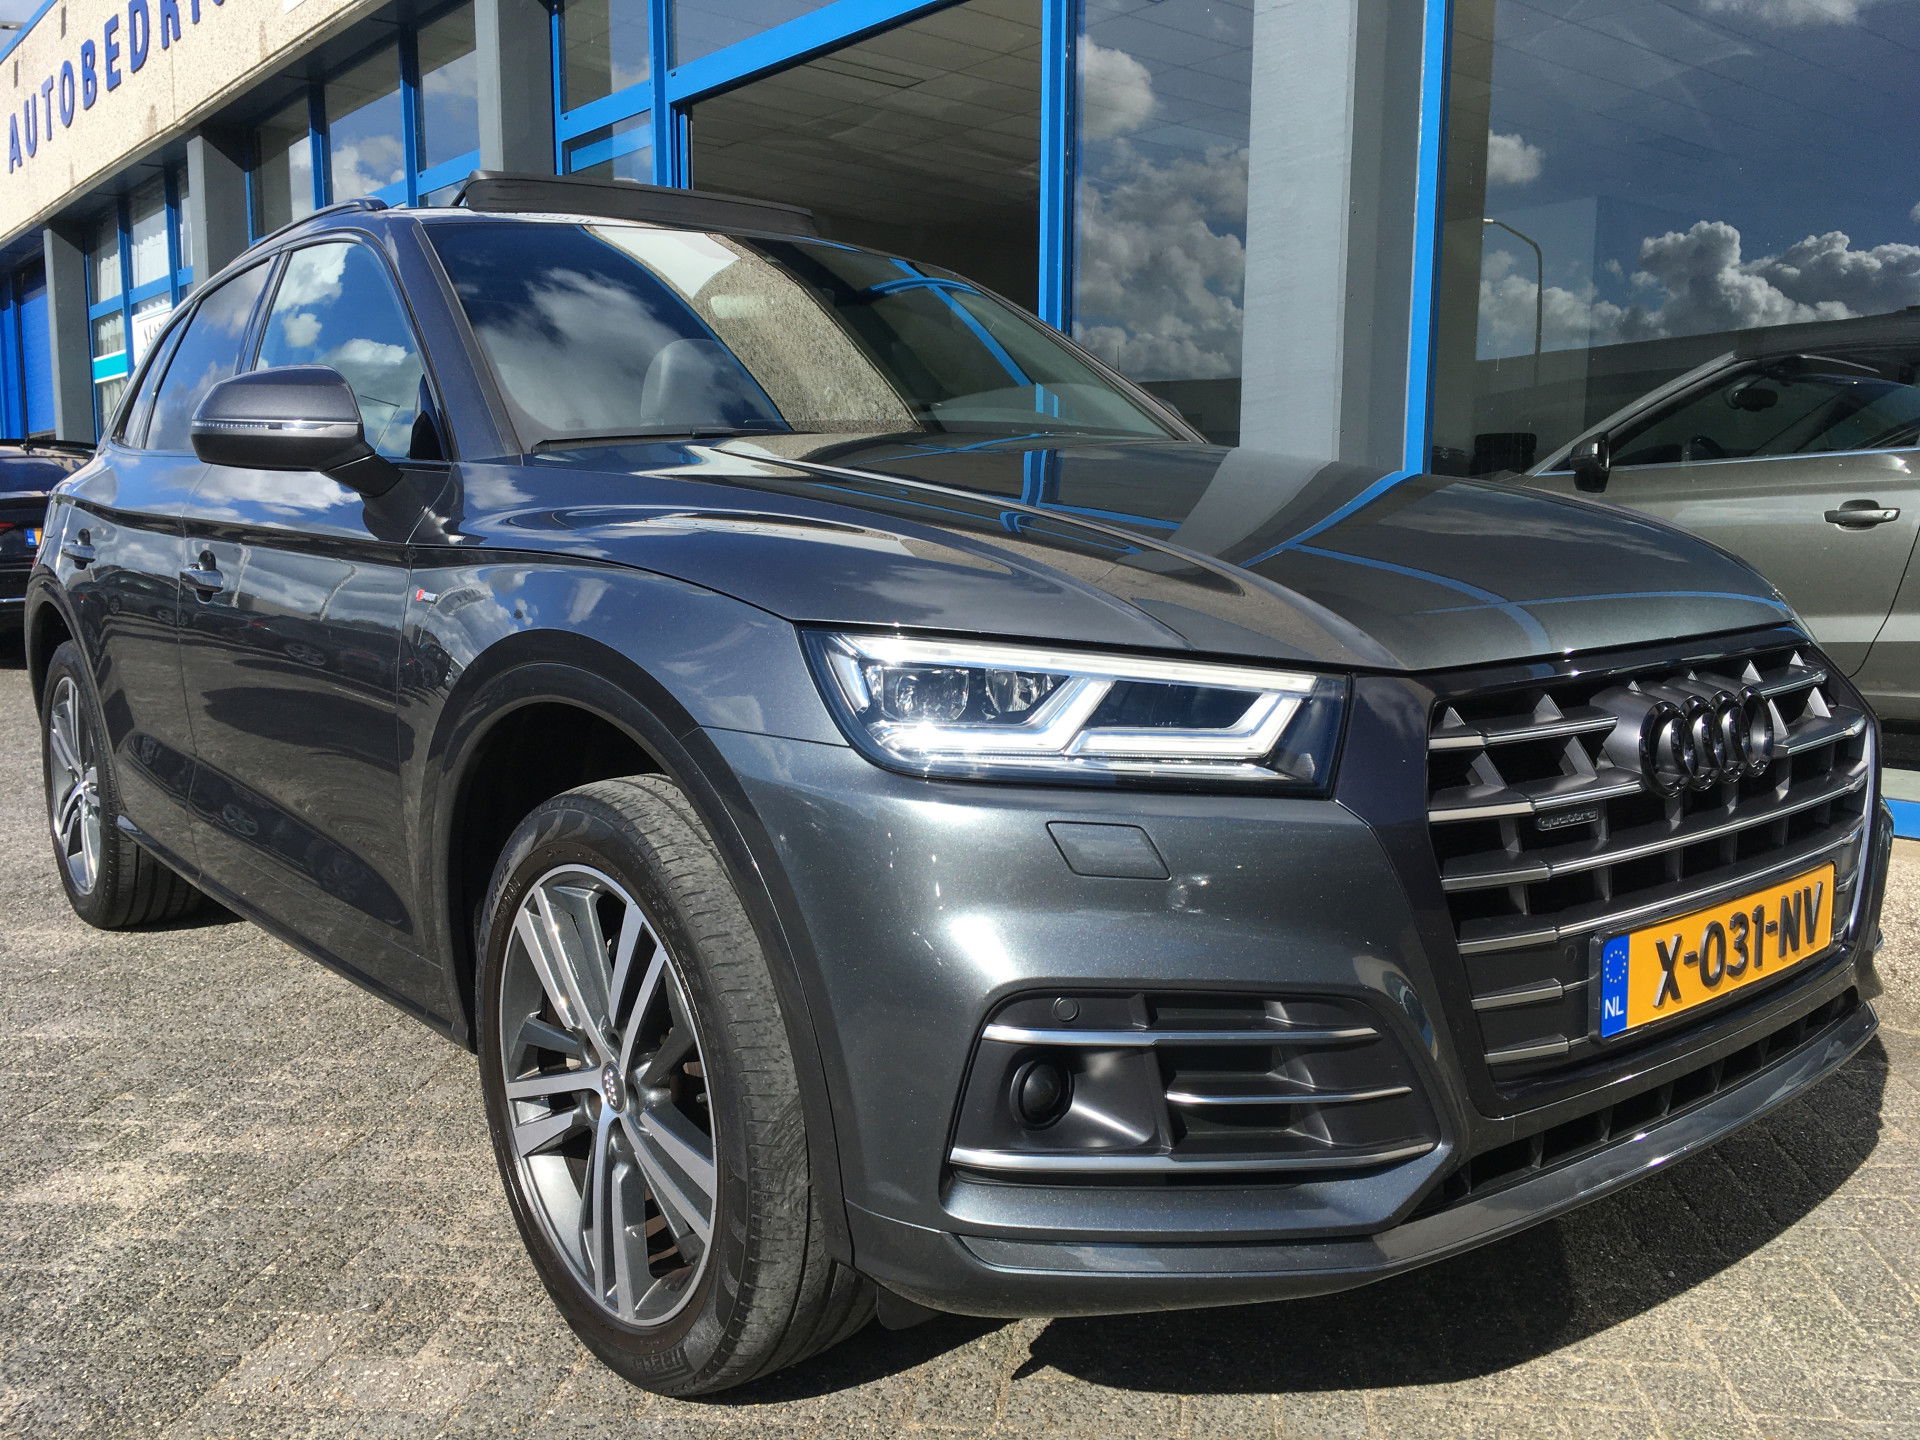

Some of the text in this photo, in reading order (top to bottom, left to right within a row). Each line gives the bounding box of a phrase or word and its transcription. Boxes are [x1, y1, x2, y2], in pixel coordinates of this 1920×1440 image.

[8, 0, 225, 173] AUTOBEDR
[1604, 995, 1624, 1020] NL
[1652, 881, 1823, 1008] X-031-NV
